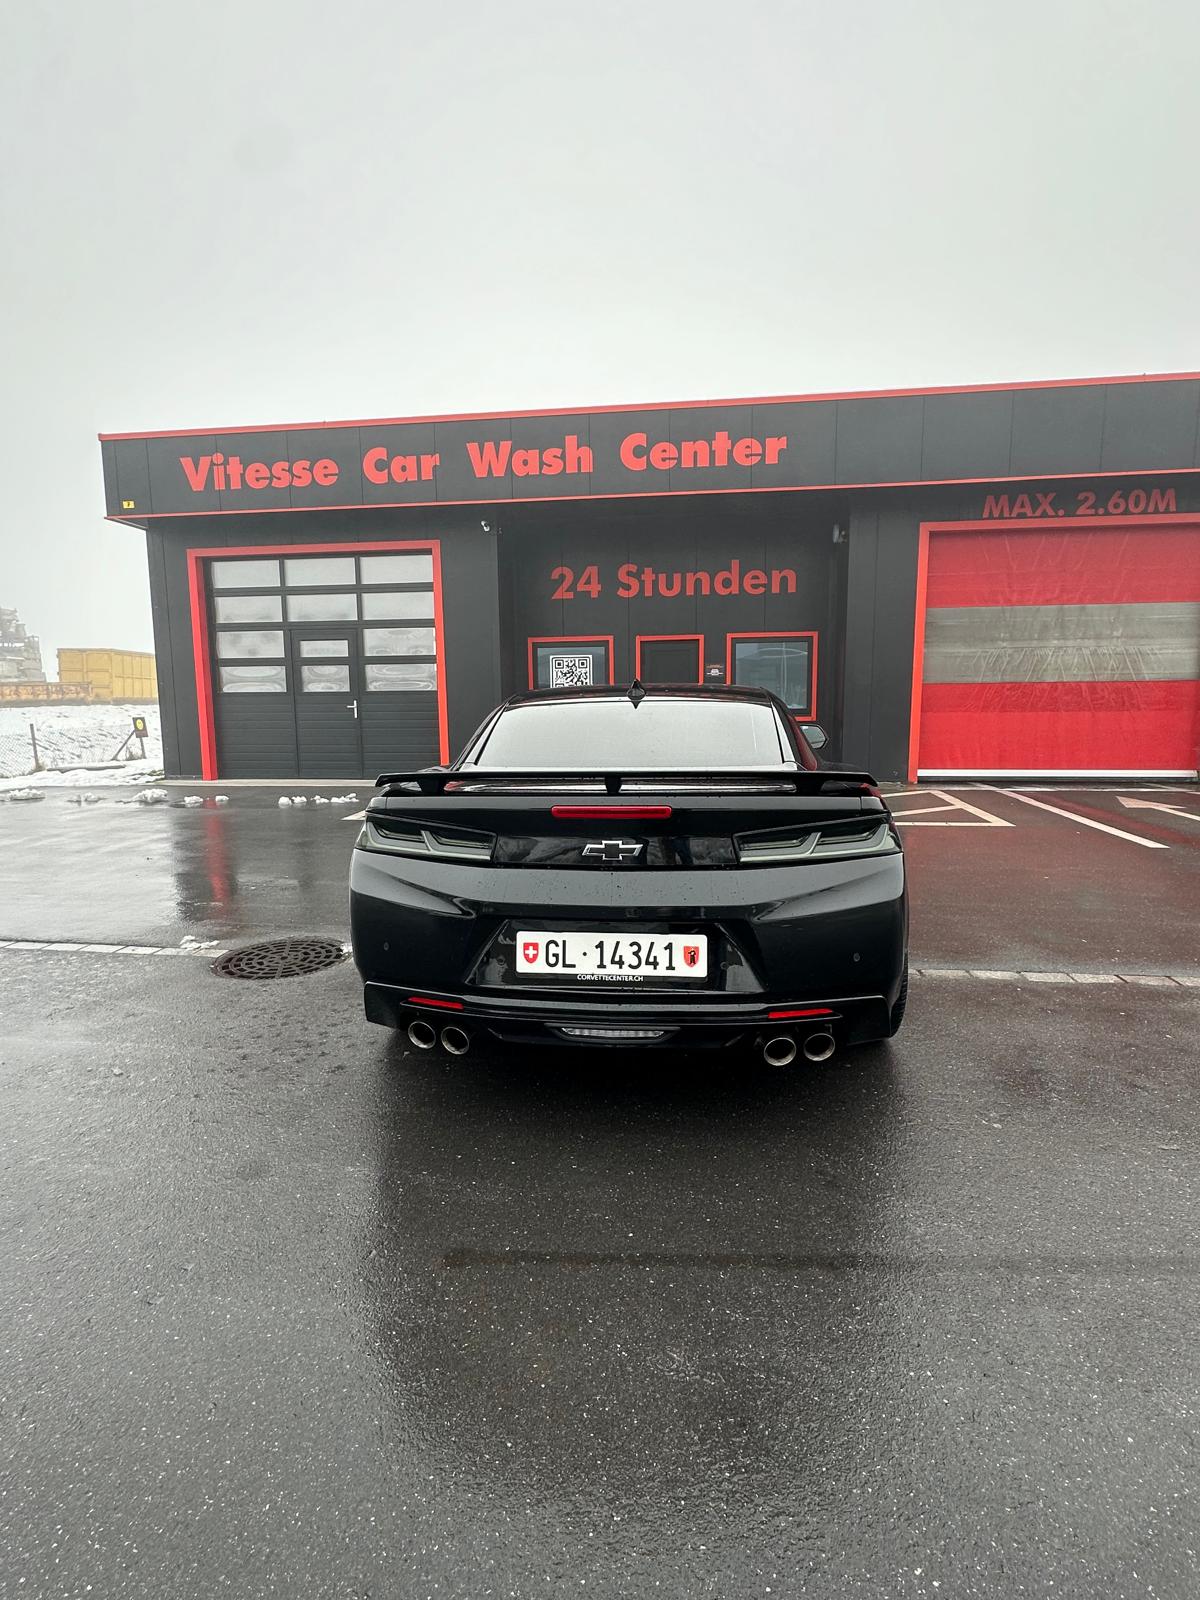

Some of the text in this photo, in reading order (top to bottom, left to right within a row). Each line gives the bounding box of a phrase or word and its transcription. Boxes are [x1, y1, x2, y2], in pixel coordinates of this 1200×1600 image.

[180, 430, 788, 492] Vitesse Car Wash Center
[982, 488, 1177, 518] MAX. 2.60M
[551, 559, 797, 600] 24 Stunden
